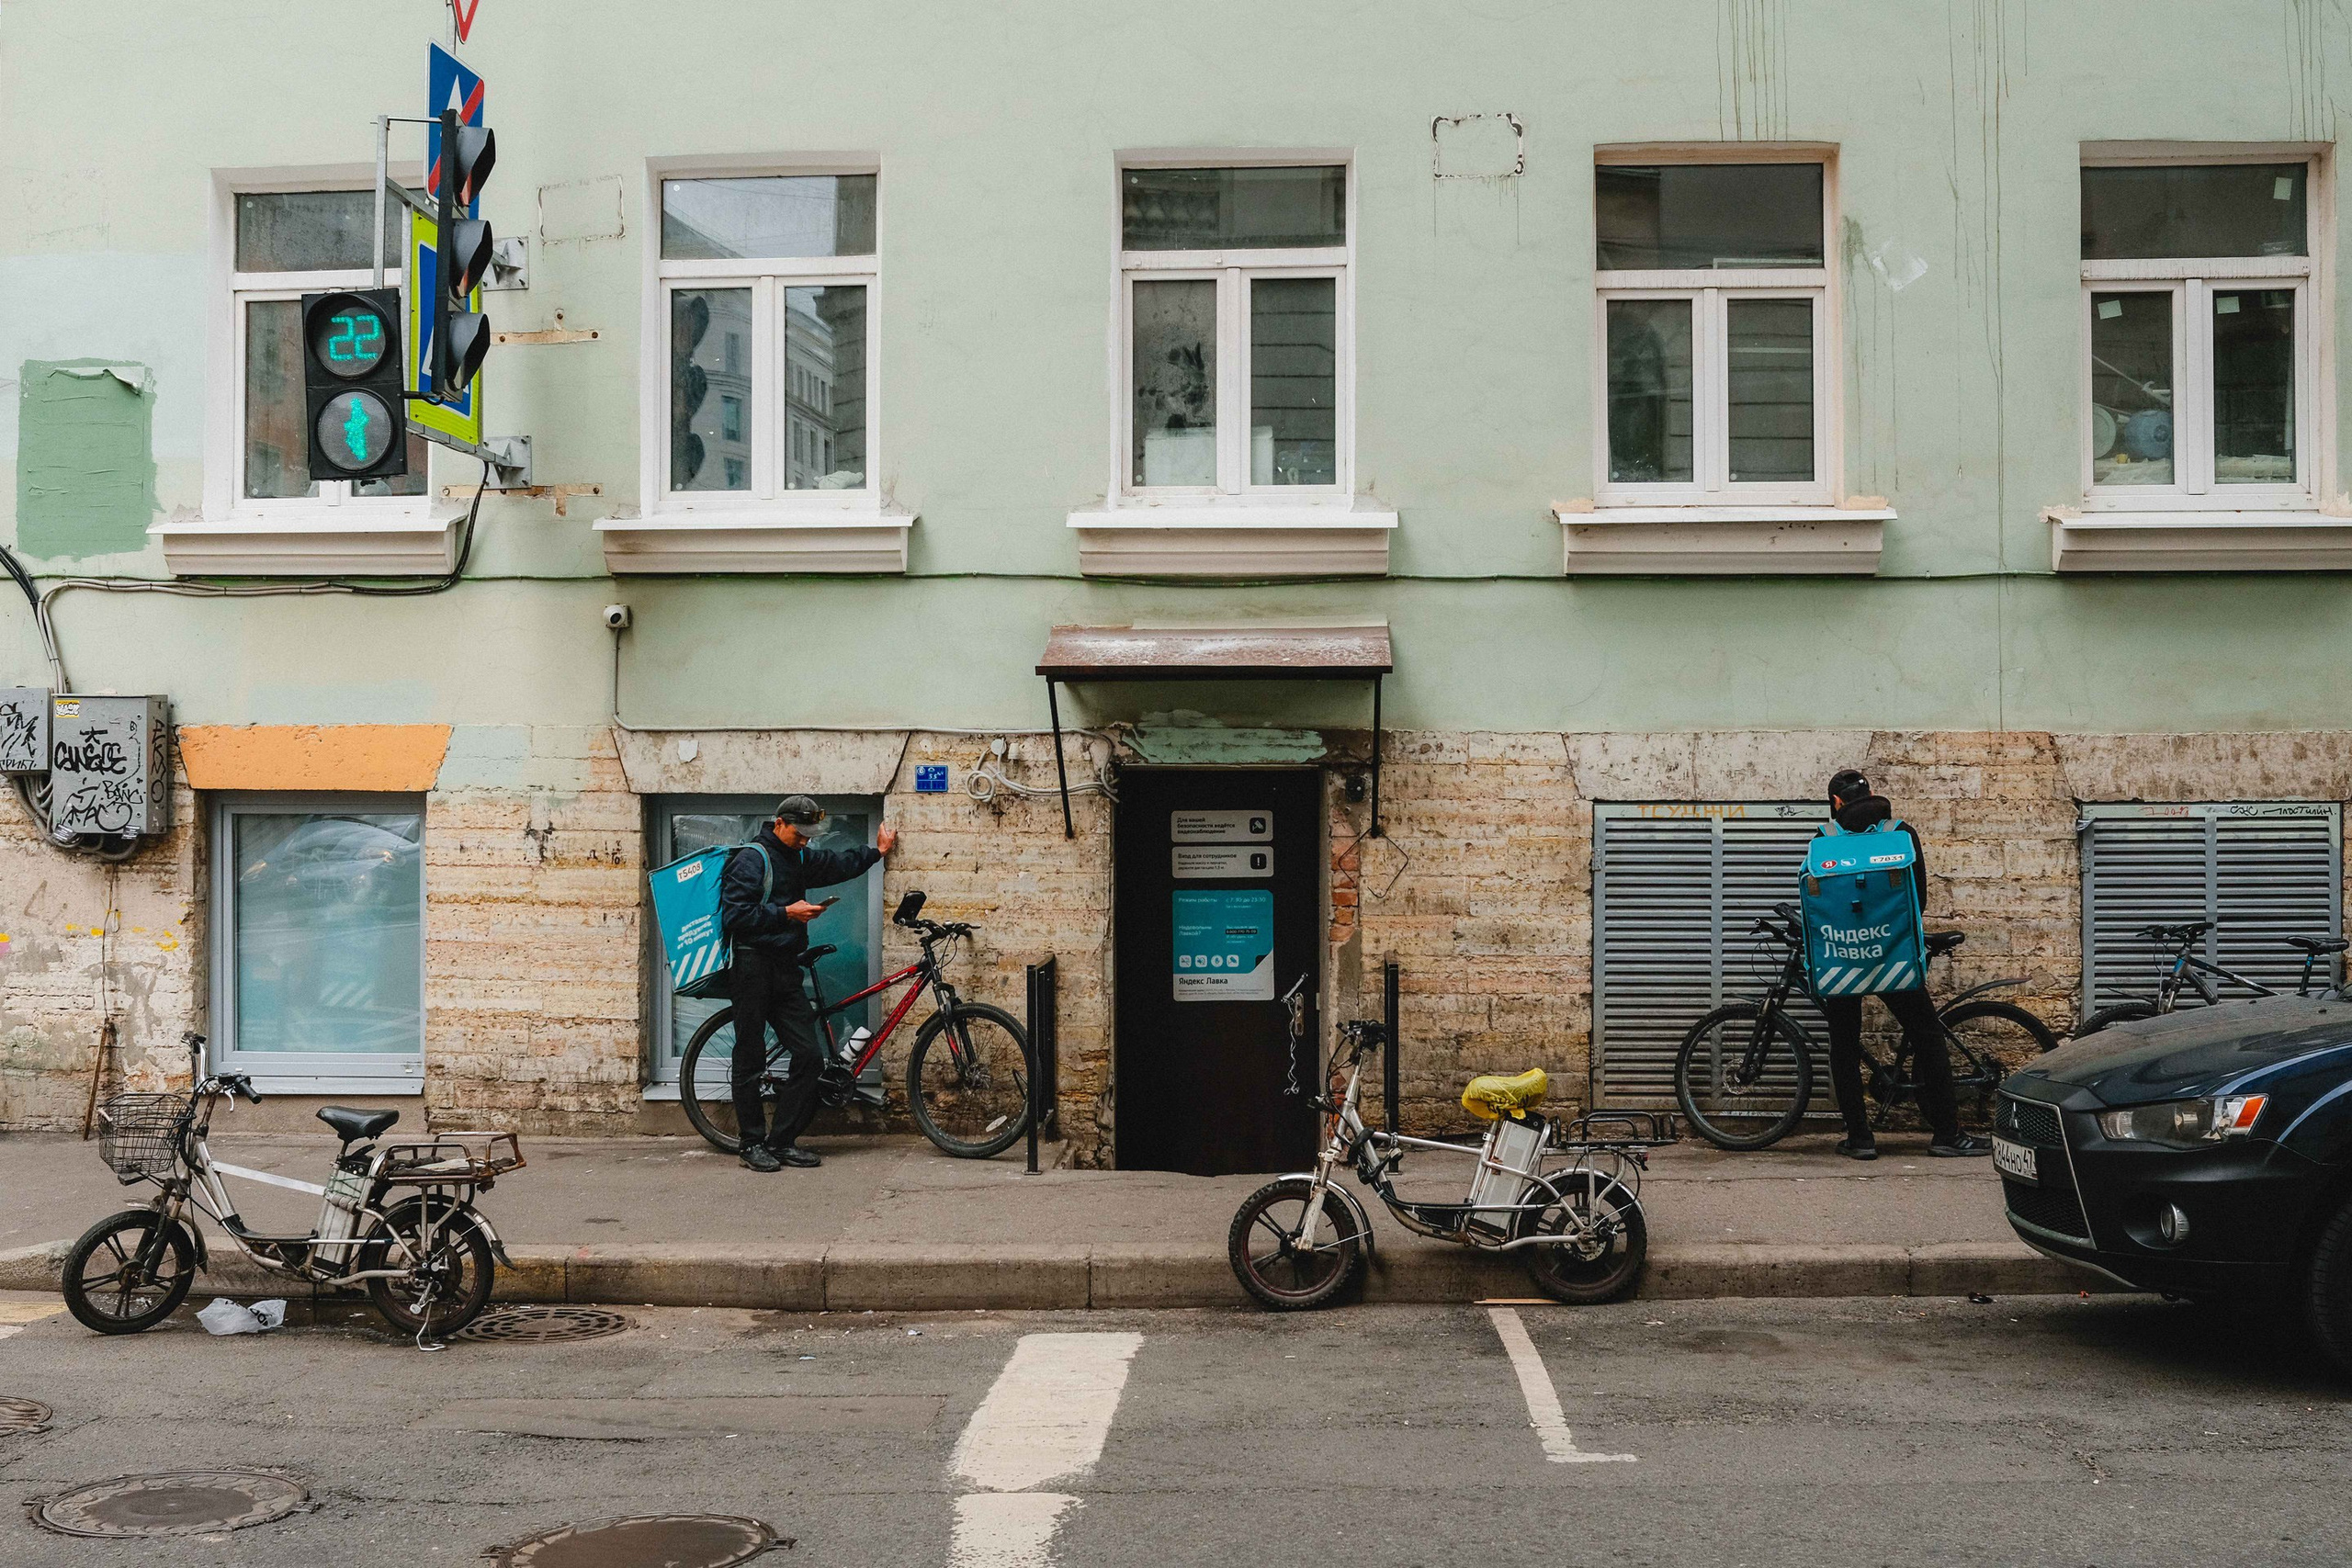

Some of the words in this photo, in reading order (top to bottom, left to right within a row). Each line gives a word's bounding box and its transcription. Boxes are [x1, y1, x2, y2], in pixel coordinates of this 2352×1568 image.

[328, 314, 380, 361] 22
[1820, 923, 1892, 944] Яндекс
[1824, 941, 1883, 960] Лавка
[1179, 977, 1204, 986] Яндекс
[1206, 976, 1228, 985] Лавка
[2023, 1149, 2032, 1170] 47
